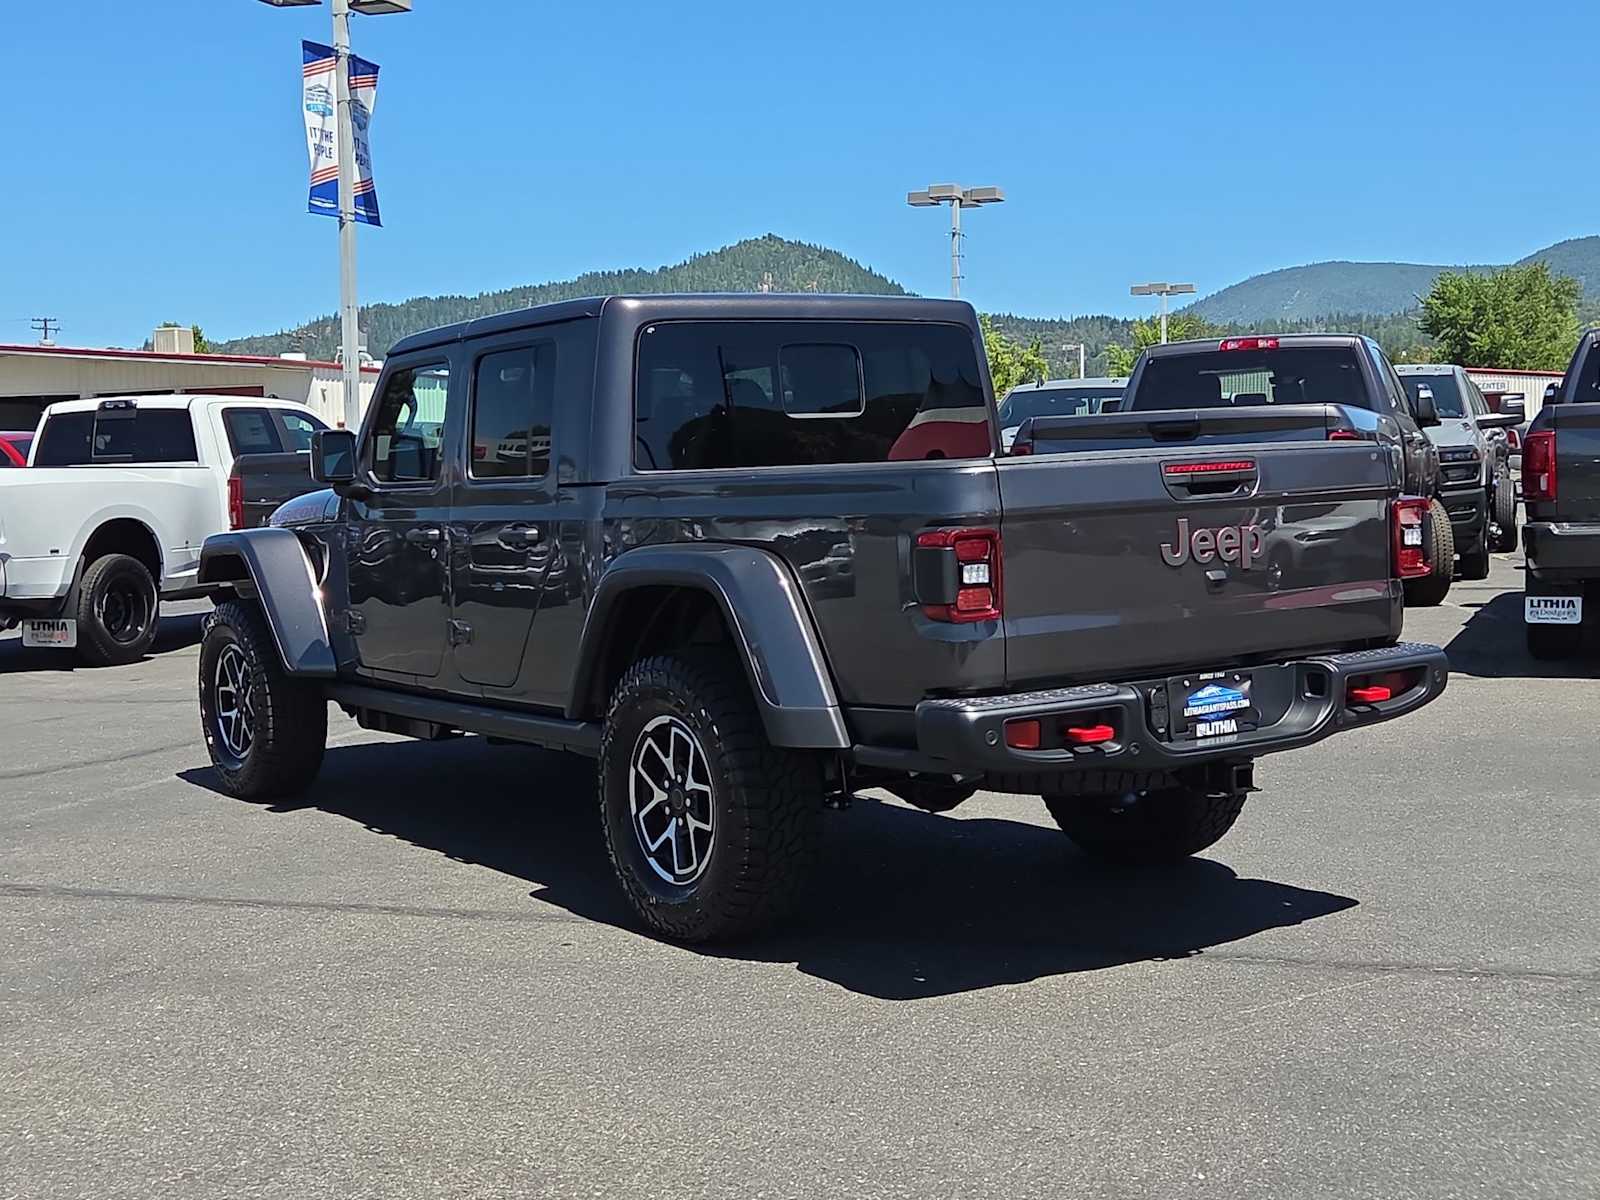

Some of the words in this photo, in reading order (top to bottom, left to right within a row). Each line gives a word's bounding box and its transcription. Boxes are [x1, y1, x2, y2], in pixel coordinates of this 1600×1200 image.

[1160, 518, 1265, 569] Jeep
[1530, 599, 1576, 609] LITHIA
[31, 621, 68, 631] LITHIA
[1203, 719, 1238, 734] LITHIA
